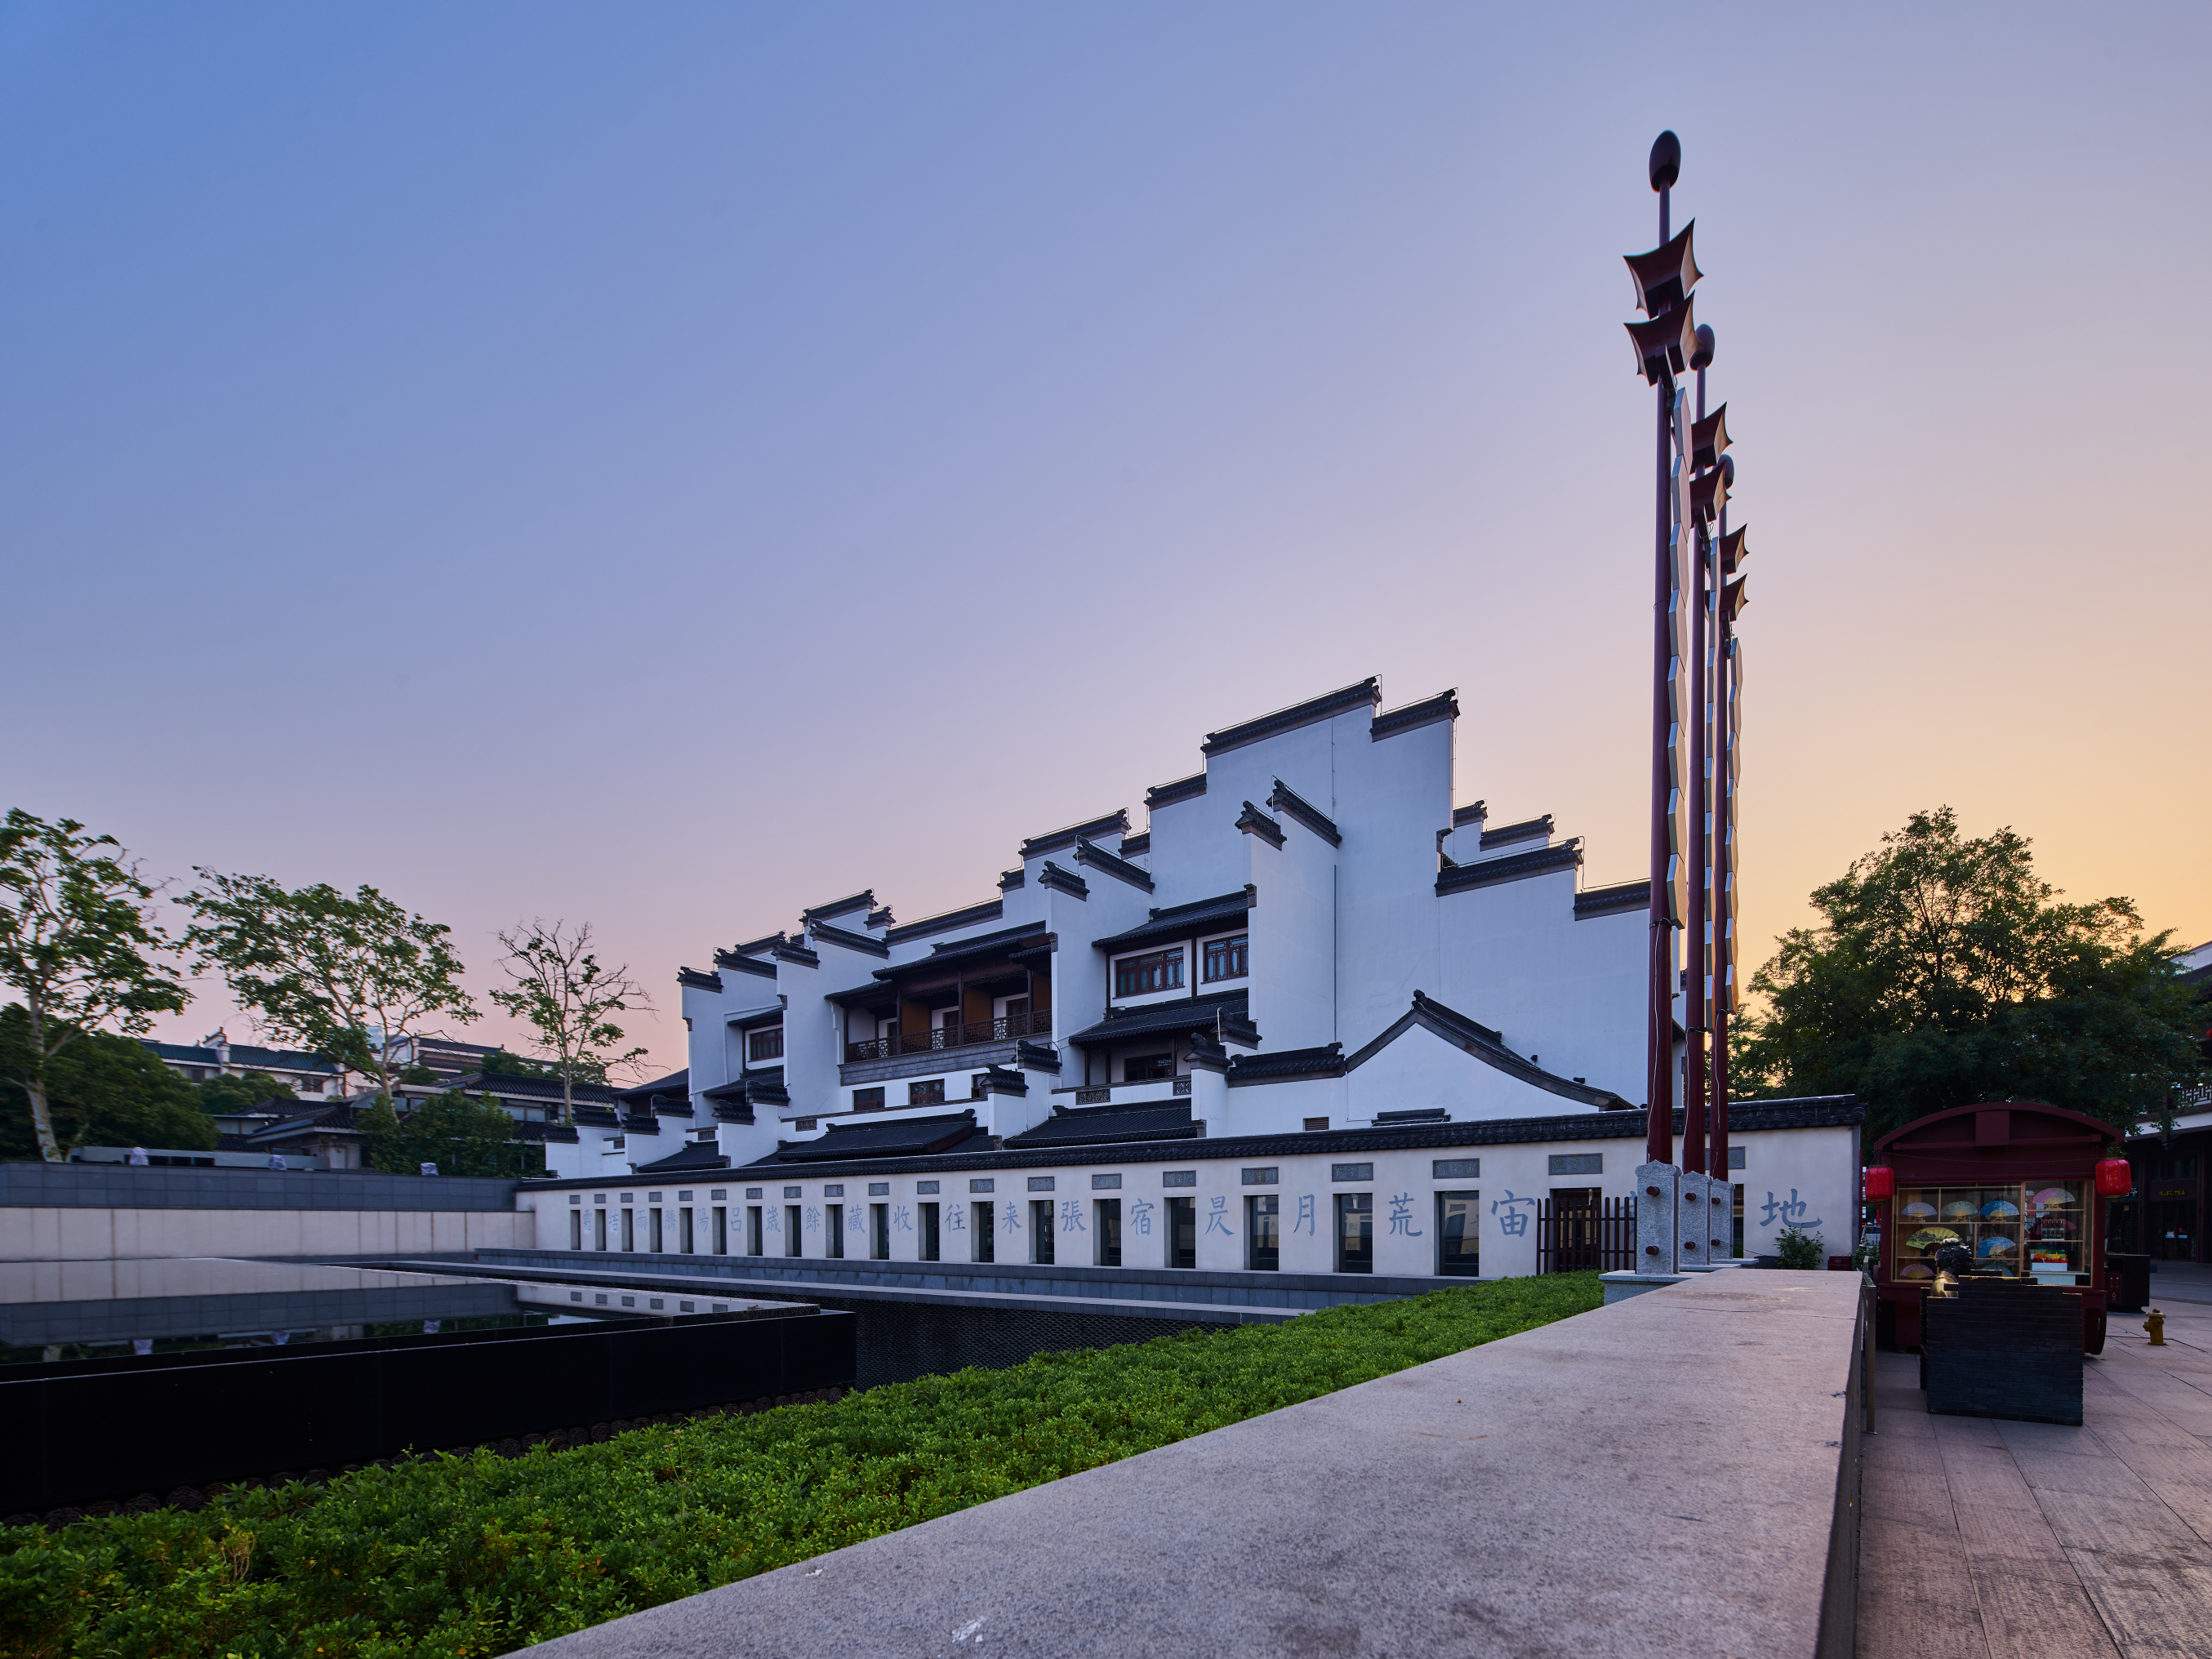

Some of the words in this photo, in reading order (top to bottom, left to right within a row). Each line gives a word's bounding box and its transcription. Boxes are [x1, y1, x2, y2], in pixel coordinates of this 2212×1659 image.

[634, 1210, 647, 1230] 雨
[894, 1206, 913, 1233] 收
[945, 1204, 966, 1231] 往
[1131, 1199, 1155, 1235] 宿
[1294, 1193, 1315, 1236] 月
[1388, 1192, 1422, 1237] 荒
[1491, 1190, 1536, 1237] 宙
[1760, 1188, 1823, 1228] 地
